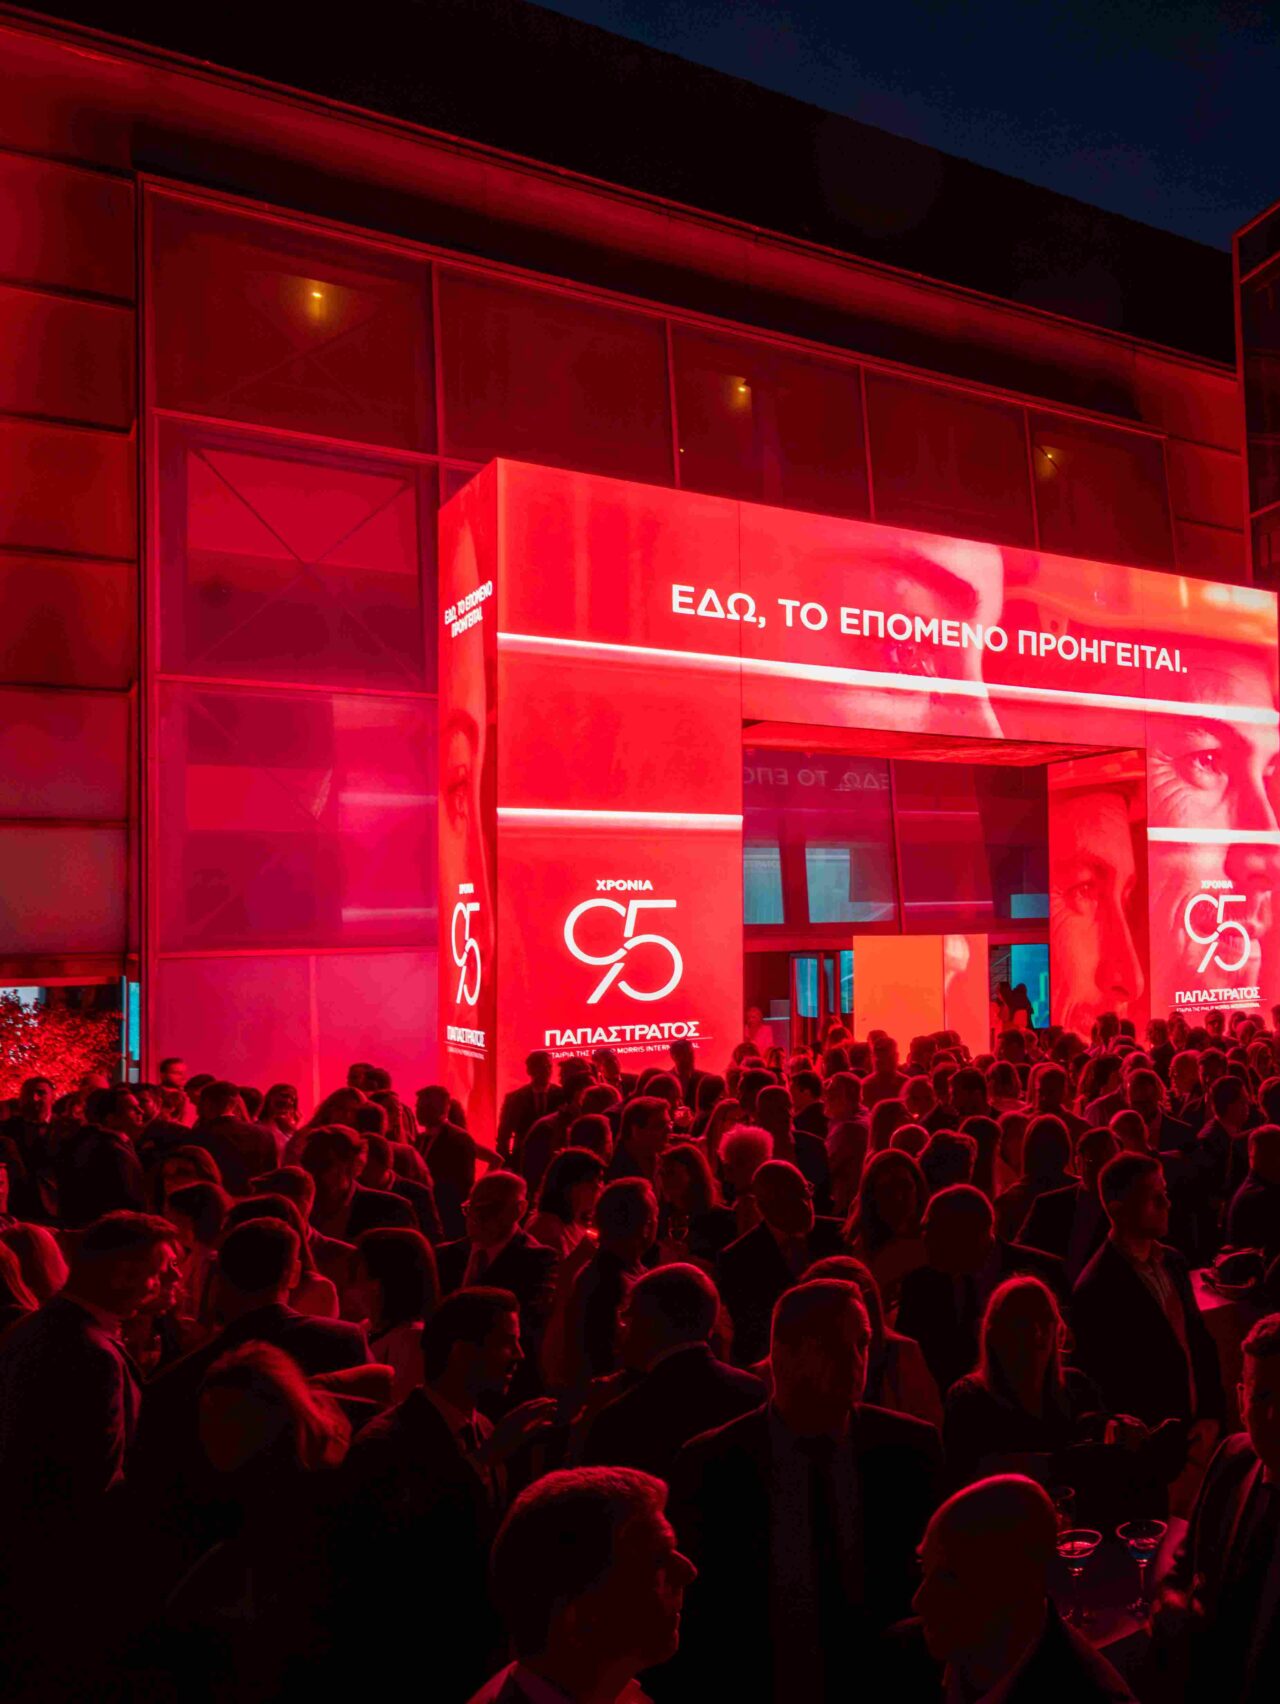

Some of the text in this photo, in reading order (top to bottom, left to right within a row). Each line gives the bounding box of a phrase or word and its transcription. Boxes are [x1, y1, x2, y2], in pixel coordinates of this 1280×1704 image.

[671, 583, 1188, 673] ΕΔΩ, ΤΟ ΕΠΟΜΕΝΟ ΠΡΟΗΓΕΙΤΑΙ.
[595, 879, 654, 891] ΧΡΟΝΙΑ
[451, 901, 482, 1006] 95
[563, 897, 684, 1005] 95
[1183, 893, 1252, 974] 95
[1174, 986, 1261, 1004] ΠΑΠΑΣΤΡΑΤΟΣ
[544, 1020, 700, 1047] ΠΑΠΑΣΤΡΑΤΟΣ
[551, 1051, 575, 1060] ΤΑΙΡΙΑ
